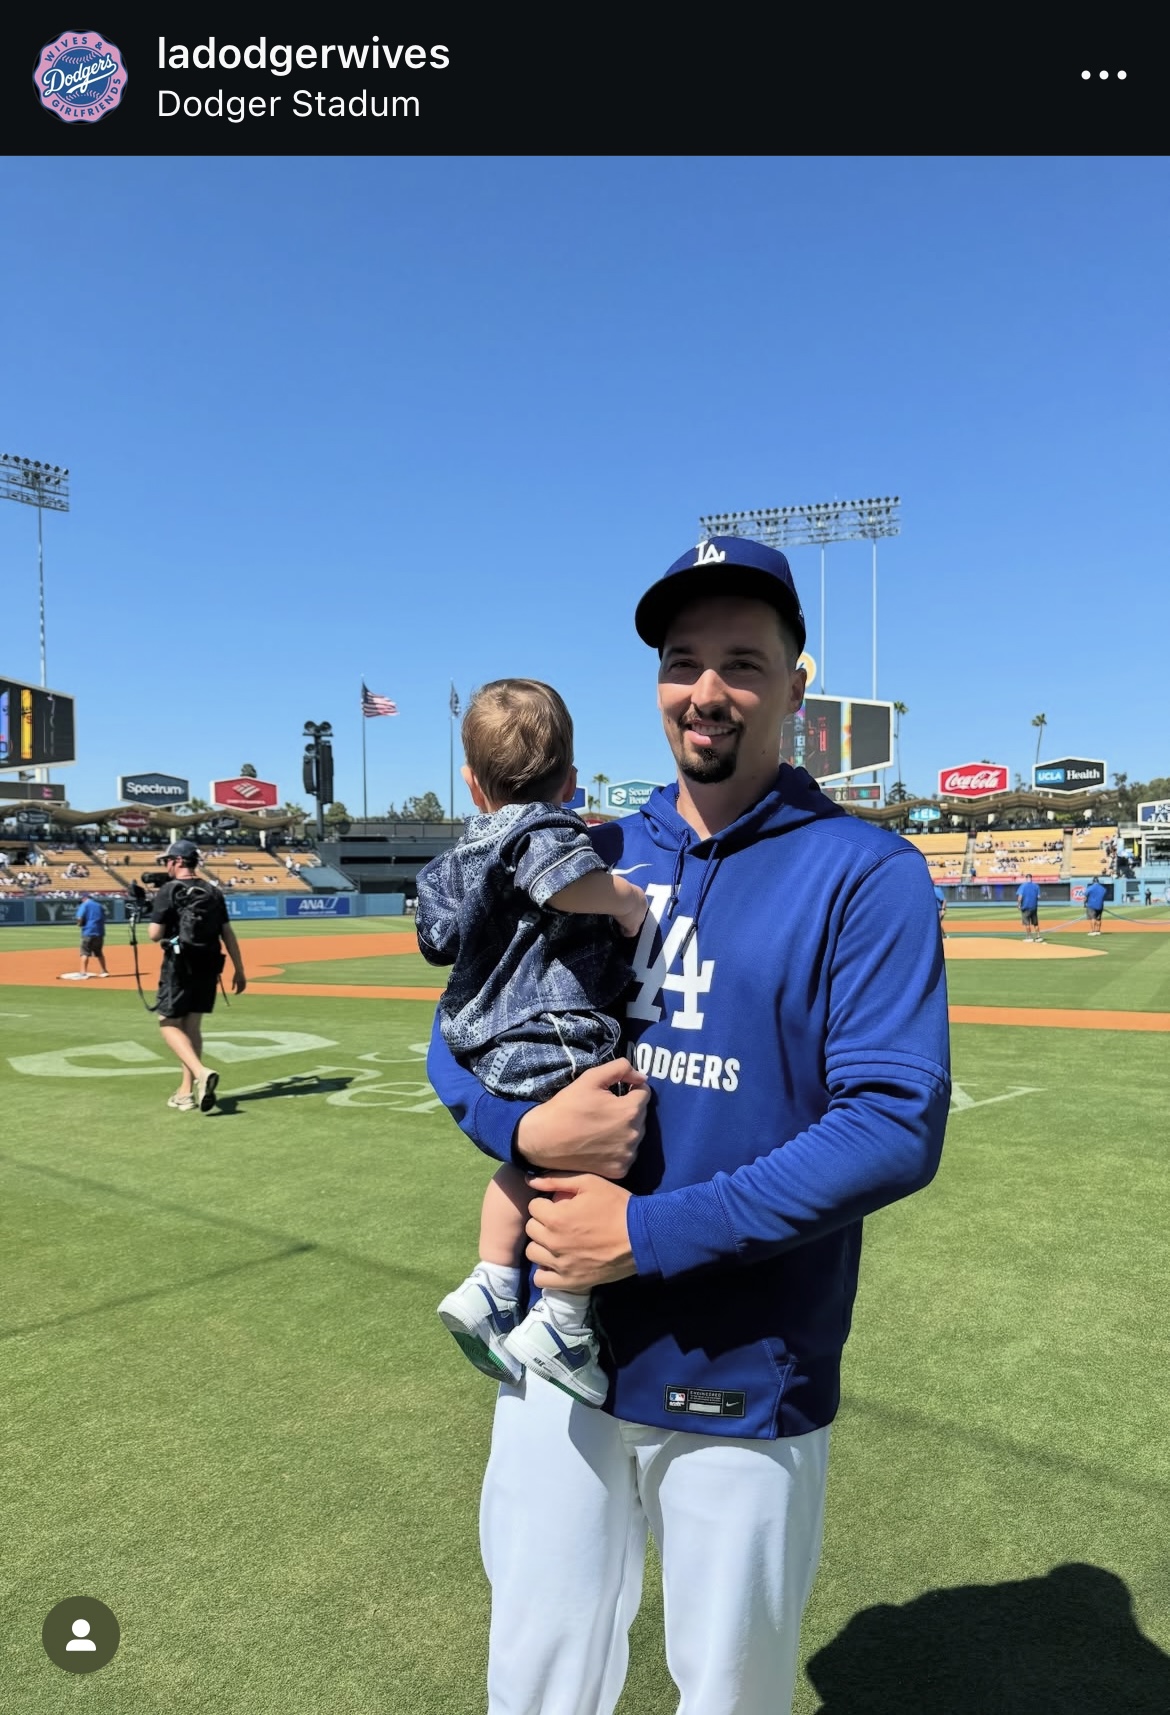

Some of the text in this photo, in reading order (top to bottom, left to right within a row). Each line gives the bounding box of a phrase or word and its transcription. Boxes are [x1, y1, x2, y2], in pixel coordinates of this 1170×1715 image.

[693, 540, 726, 566] LA
[1037, 768, 1100, 782] UCLA Health
[126, 781, 183, 796] Spectrum
[298, 899, 324, 910] ANA
[626, 883, 716, 1030] LA
